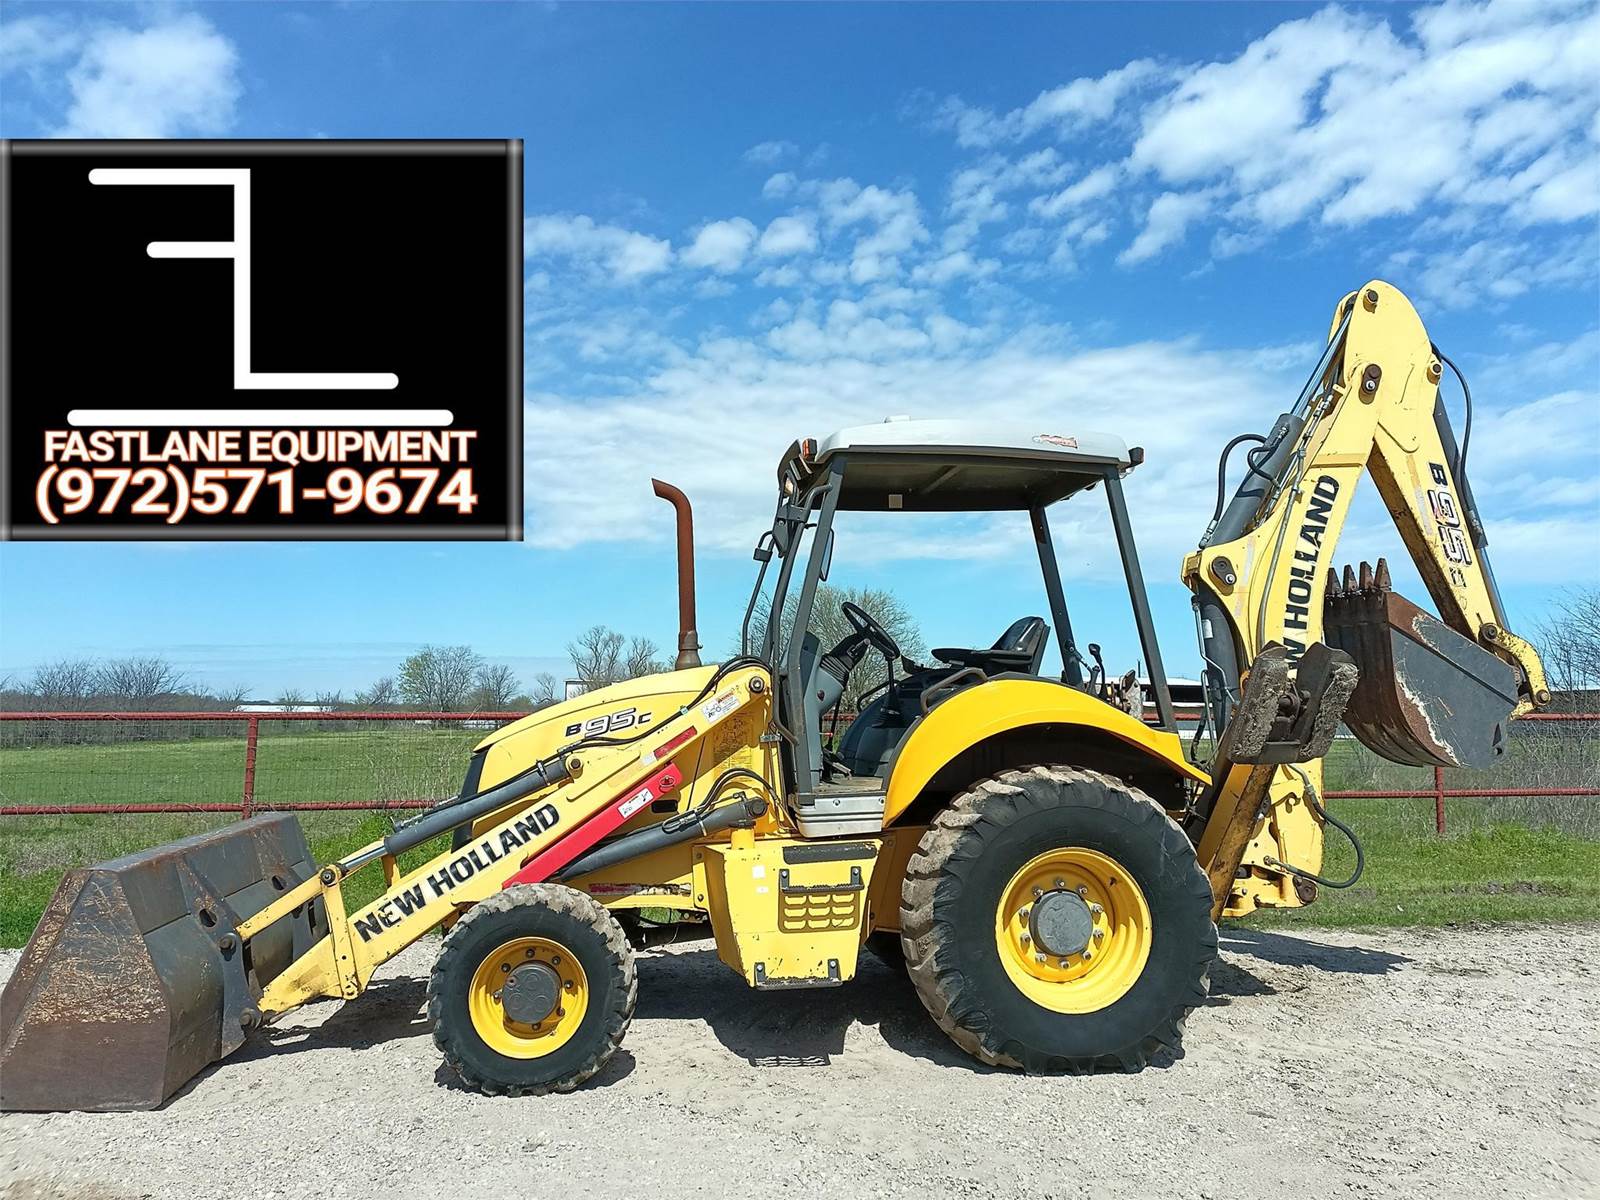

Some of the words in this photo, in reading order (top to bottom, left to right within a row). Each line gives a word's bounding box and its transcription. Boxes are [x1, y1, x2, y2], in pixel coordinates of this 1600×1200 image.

[1283, 474, 1340, 630] HOLLAND
[354, 884, 427, 943] NEW
[426, 803, 560, 898] HOLLAND
